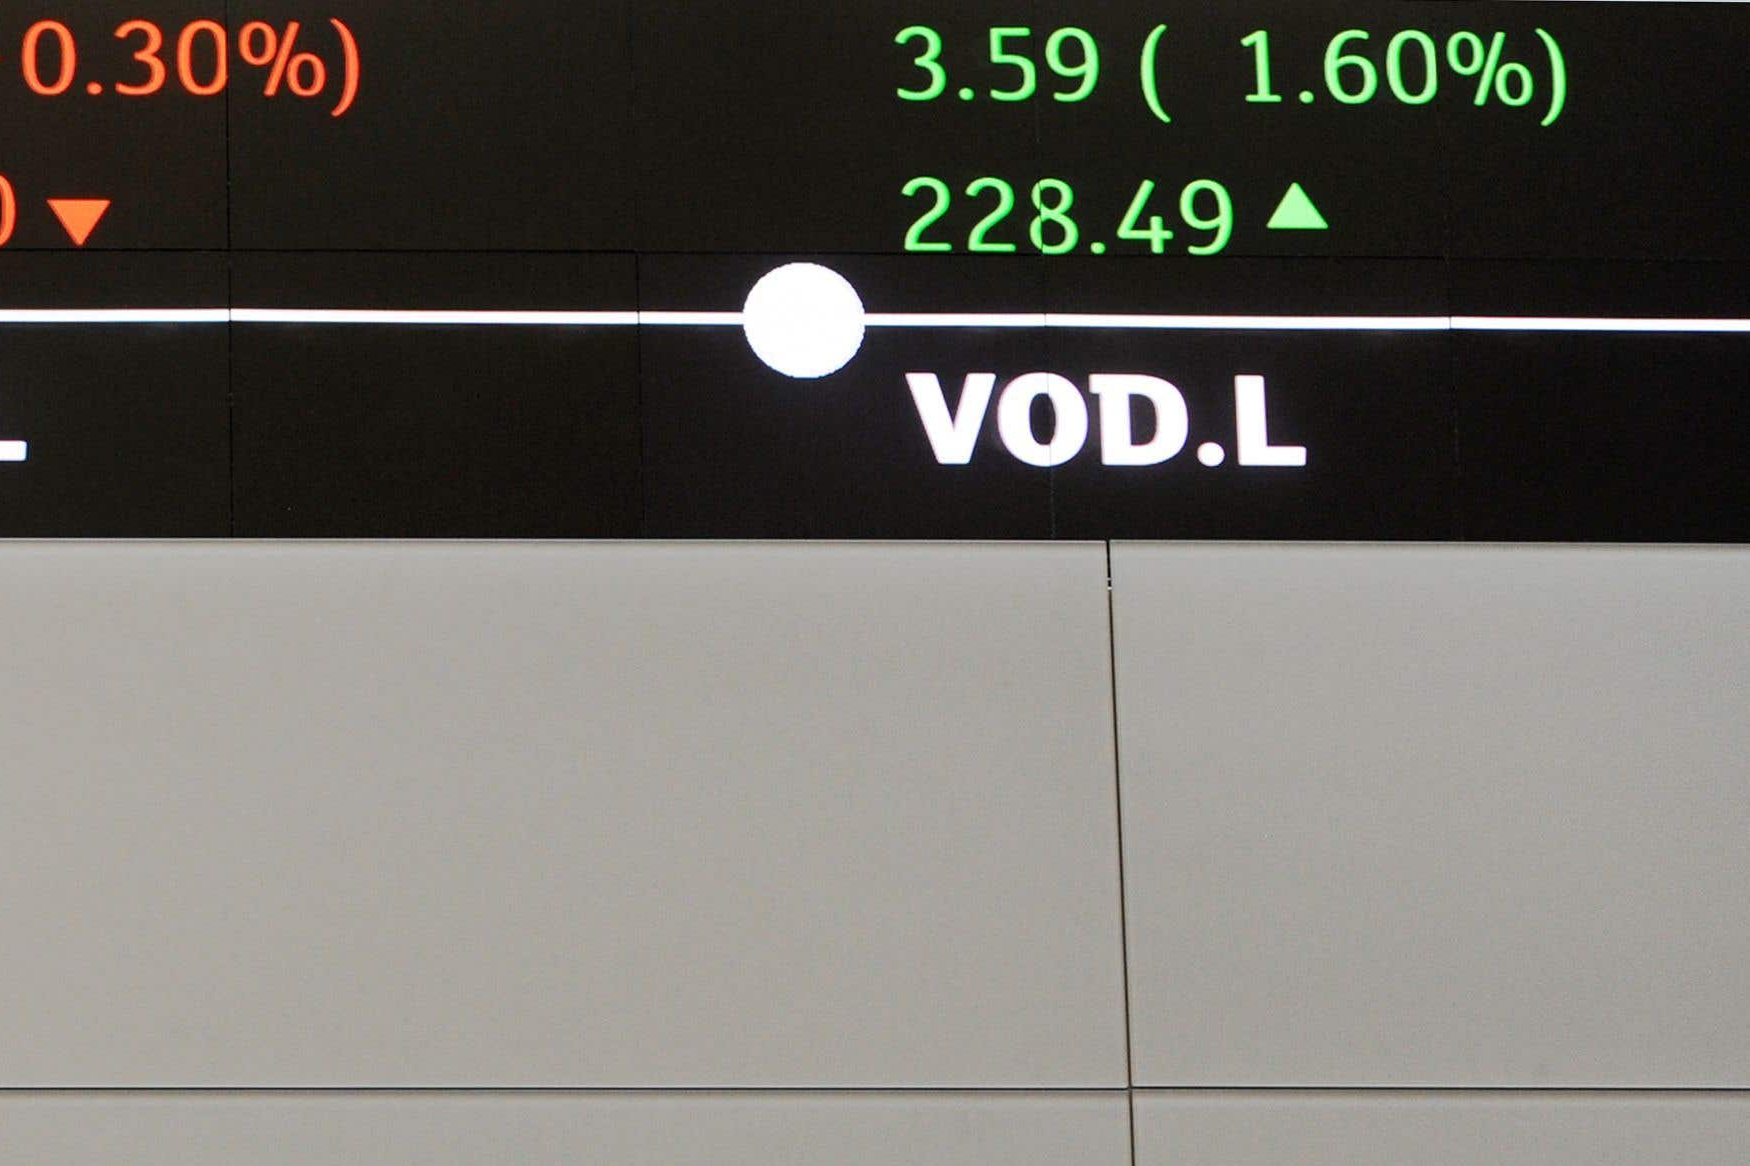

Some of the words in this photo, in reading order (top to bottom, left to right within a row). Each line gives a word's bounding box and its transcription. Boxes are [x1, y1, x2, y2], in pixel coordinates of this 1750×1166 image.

[894, 25, 1100, 103] 3.59
[901, 176, 1235, 256] 228.49
[904, 372, 1308, 468] VOD.L
